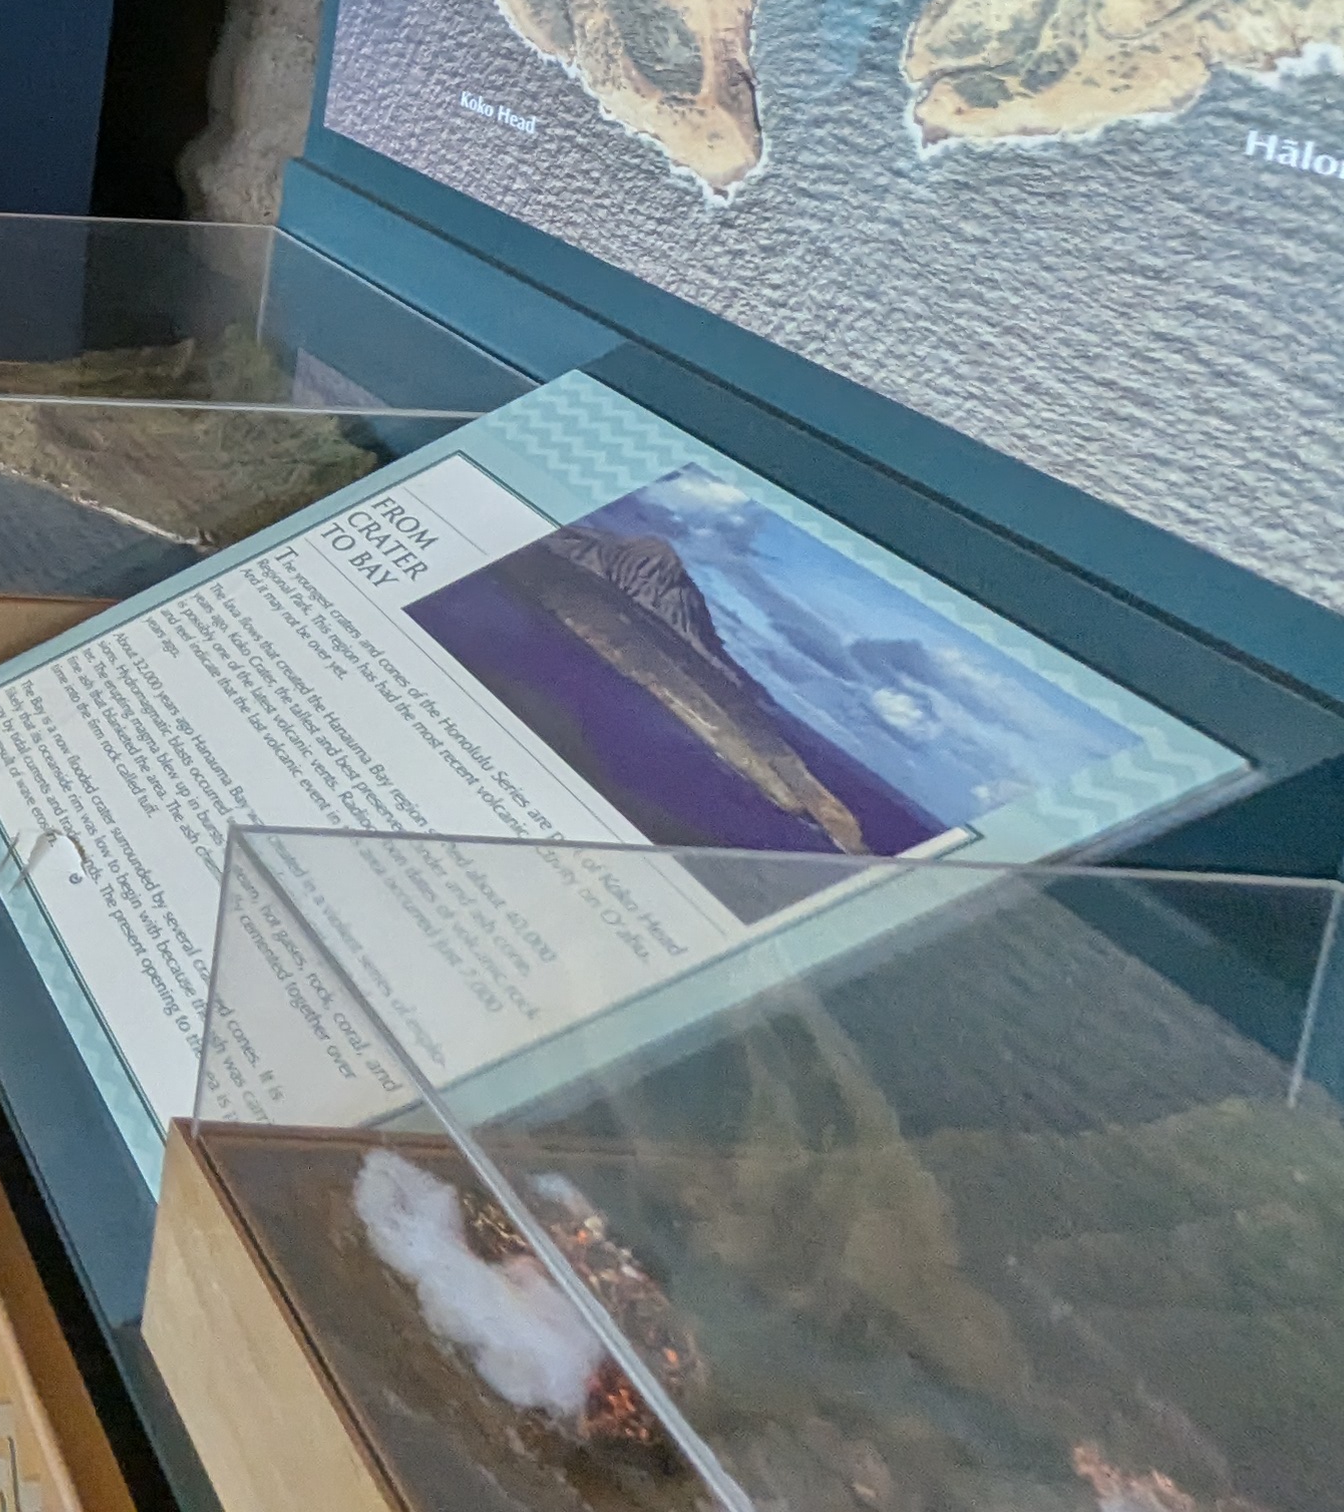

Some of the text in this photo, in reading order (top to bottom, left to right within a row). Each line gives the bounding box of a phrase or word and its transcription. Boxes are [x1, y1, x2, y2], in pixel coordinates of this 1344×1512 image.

[460, 90, 537, 134] Koko Head
[320, 522, 400, 588] TO BAY
[346, 511, 429, 582] CRATER
[370, 496, 440, 551] FROM
[281, 611, 301, 627] not
[307, 640, 332, 660] over
[87, 718, 105, 740] firm
[100, 740, 122, 763] rock
[116, 763, 146, 795] called
[102, 707, 142, 755] blanketed
[133, 754, 150, 773] the
[165, 798, 184, 822] The
[179, 824, 200, 844] ash
[153, 690, 180, 716] years
[175, 716, 194, 736] ago
[191, 734, 232, 786] Hanauma
[228, 785, 249, 809] Bay
[167, 735, 193, 766] blasts
[189, 767, 233, 815] occurred
[217, 677, 238, 698] that
[232, 695, 251, 713] the
[247, 712, 268, 733] last
[263, 733, 303, 777] volcanic
[299, 778, 331, 811] event
[236, 670, 254, 688] the
[250, 686, 277, 714] latest
[273, 714, 313, 758] volcanic
[259, 640, 280, 660] that
[275, 660, 314, 695] created
[306, 694, 326, 713] the
[323, 711, 371, 764] Hanauma
[368, 764, 394, 787] Bay
[389, 788, 427, 827] region
[274, 686, 293, 704] the
[289, 703, 321, 735] tallest
[315, 735, 343, 757] and
[334, 754, 361, 781] best
[311, 613, 331, 634] This
[328, 634, 360, 664] region
[356, 661, 378, 682] has
[374, 680, 402, 703] had
[394, 702, 415, 721] the
[412, 721, 444, 749] most
[439, 749, 480, 785] recent
[476, 786, 529, 839] volcanic
[329, 609, 361, 639] craters
[358, 639, 385, 658] and
[378, 658, 410, 687] cones
[419, 699, 440, 718] the
[438, 717, 493, 771] Honolulu
[490, 771, 530, 808] Series
[527, 809, 552, 830] are
[16, 778, 36, 806] wave
[130, 717, 160, 754] magma
[156, 752, 179, 779] blew
[196, 809, 230, 844] bursts
[23, 755, 51, 794] currents
[46, 795, 68, 816] and
[99, 882, 117, 908] The
[108, 909, 147, 956] present
[141, 957, 180, 1016] opening
[38, 744, 73, 792] oceanside
[67, 793, 84, 813] rim
[80, 813, 98, 836] was
[93, 834, 112, 858] low
[112, 872, 142, 909] begin
[139, 910, 162, 940] with
[156, 939, 196, 996] because
[52, 733, 71, 754] now
[67, 755, 99, 794] flooded
[91, 795, 116, 824] crater
[110, 827, 160, 891] surrounded
[163, 911, 202, 956] several
[239, 914, 357, 1078] cemented together over
[259, 903, 281, 928] hot
[365, 1060, 404, 1092] and
